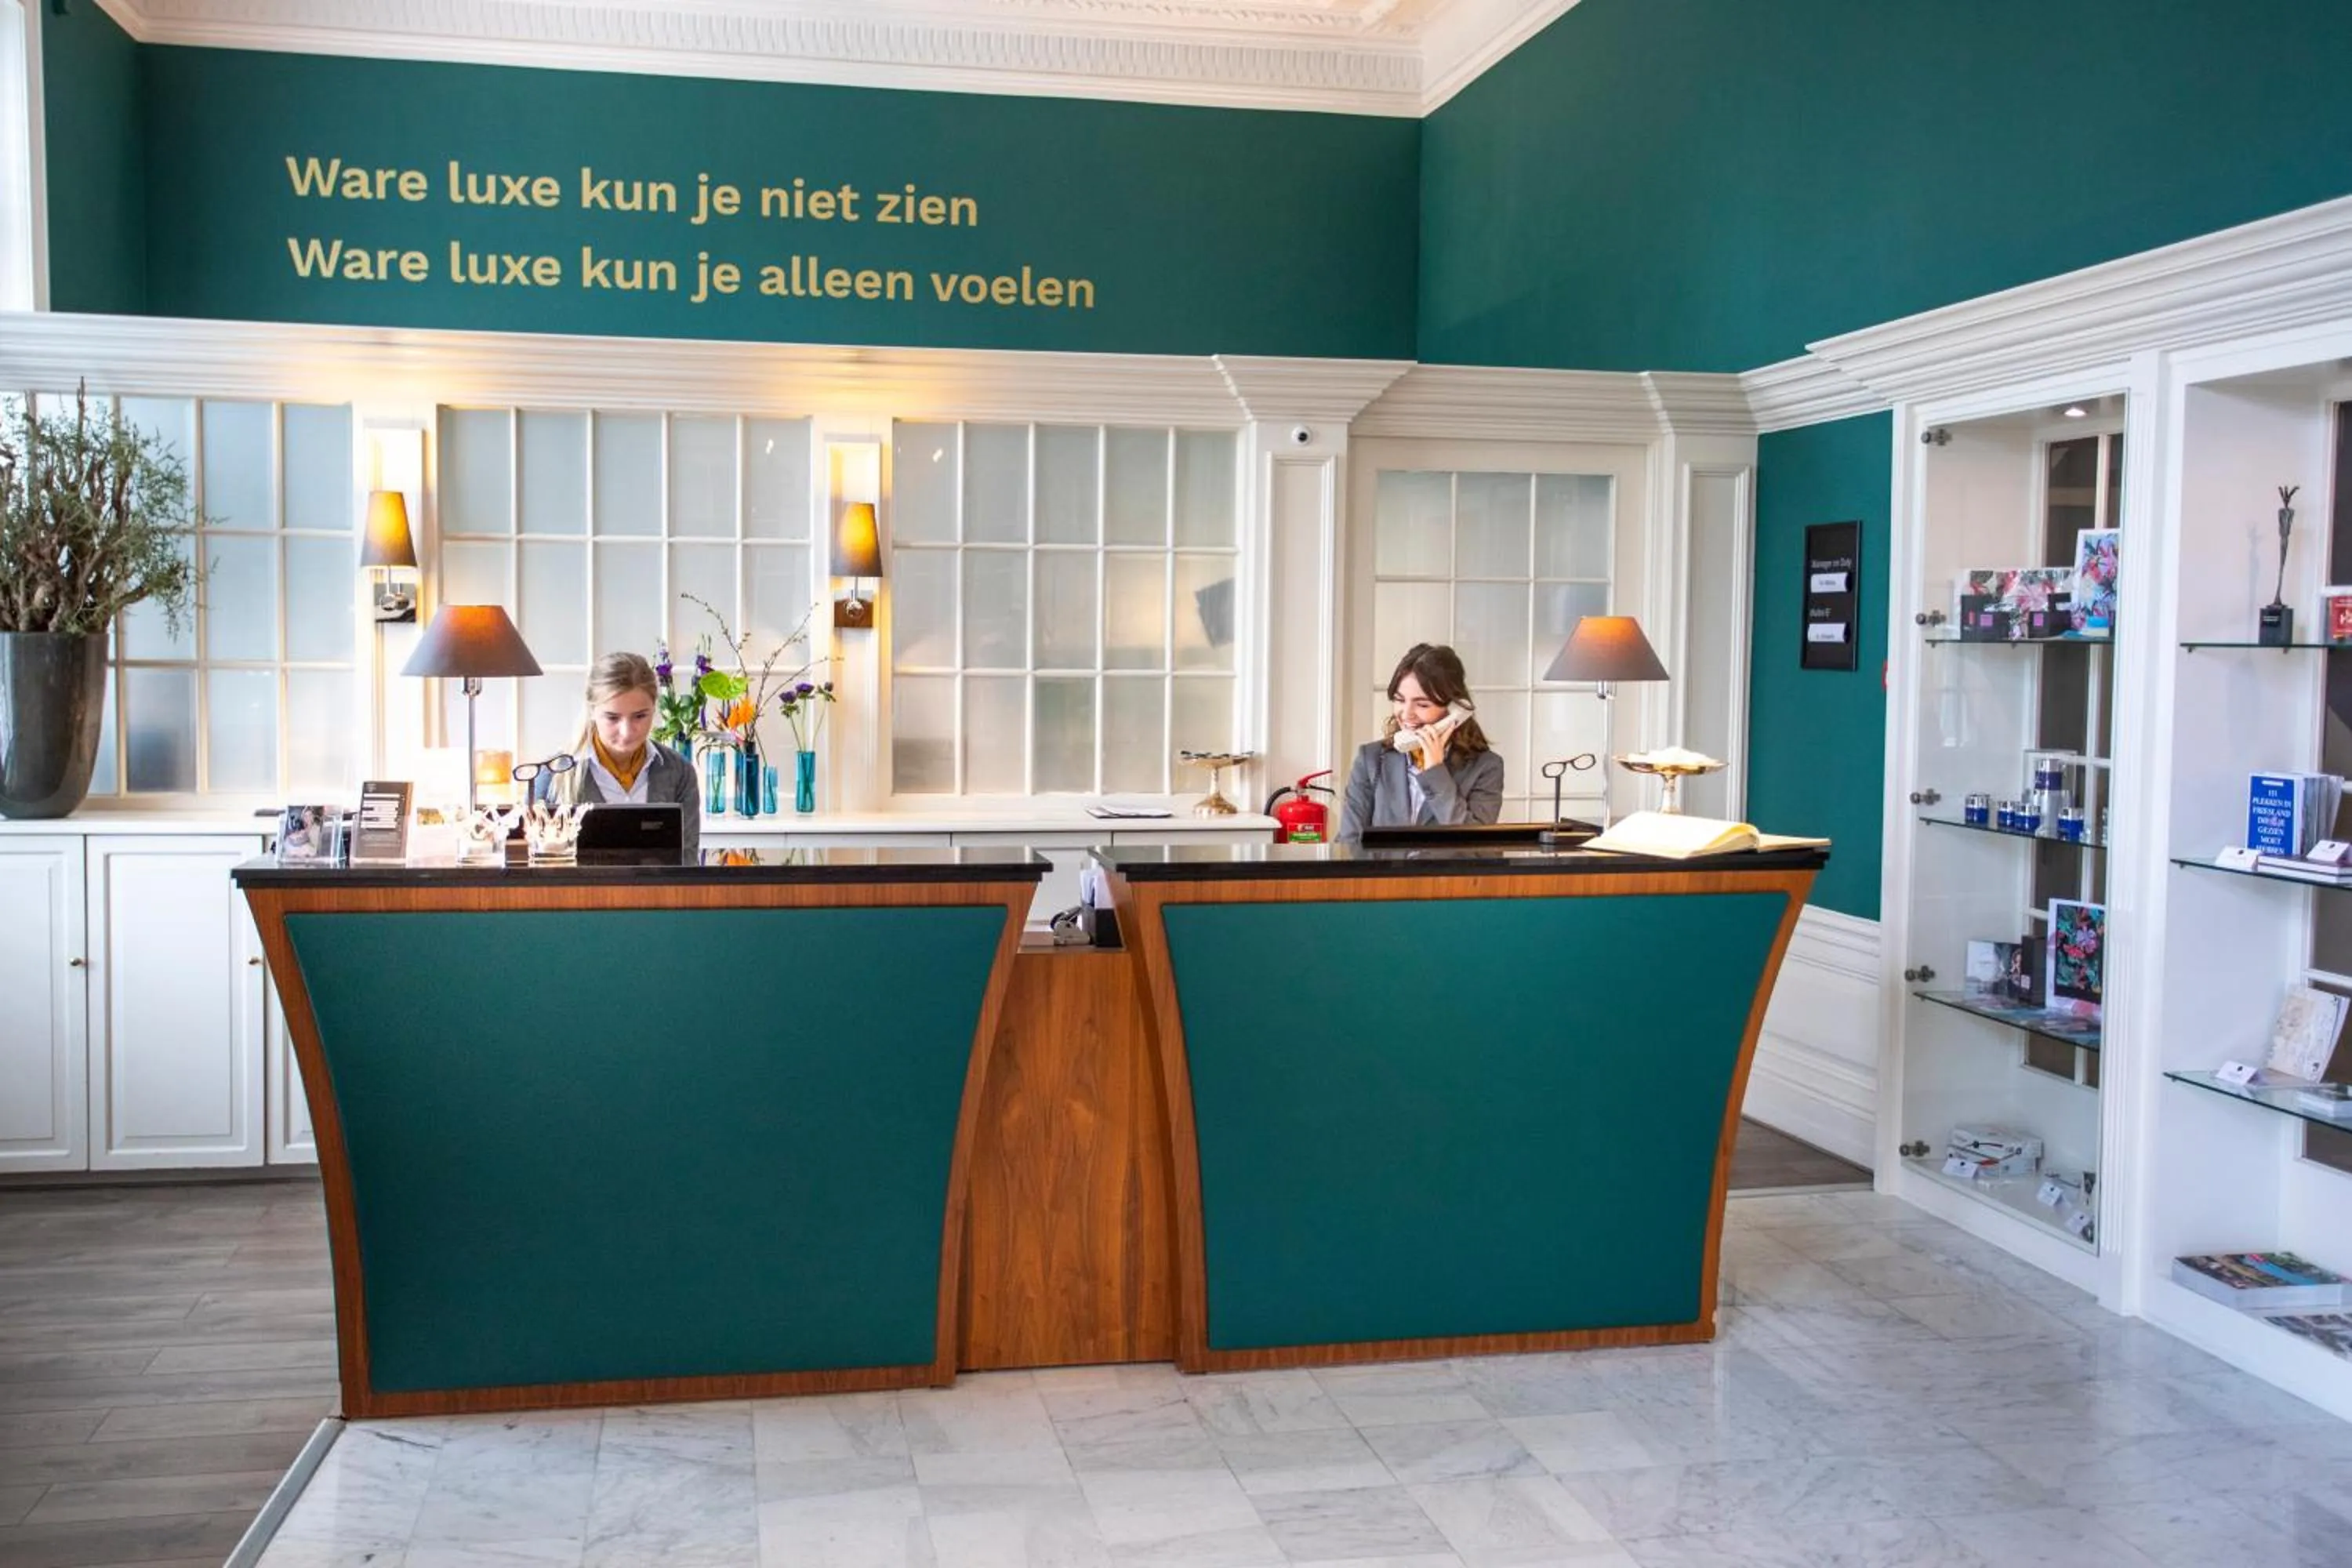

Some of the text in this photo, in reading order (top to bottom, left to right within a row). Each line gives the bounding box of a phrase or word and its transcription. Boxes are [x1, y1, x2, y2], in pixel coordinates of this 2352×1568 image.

[286, 157, 978, 226] Ware luxe kun je niet zien
[288, 238, 1094, 307] Ware luxe kun je alleen voelen
